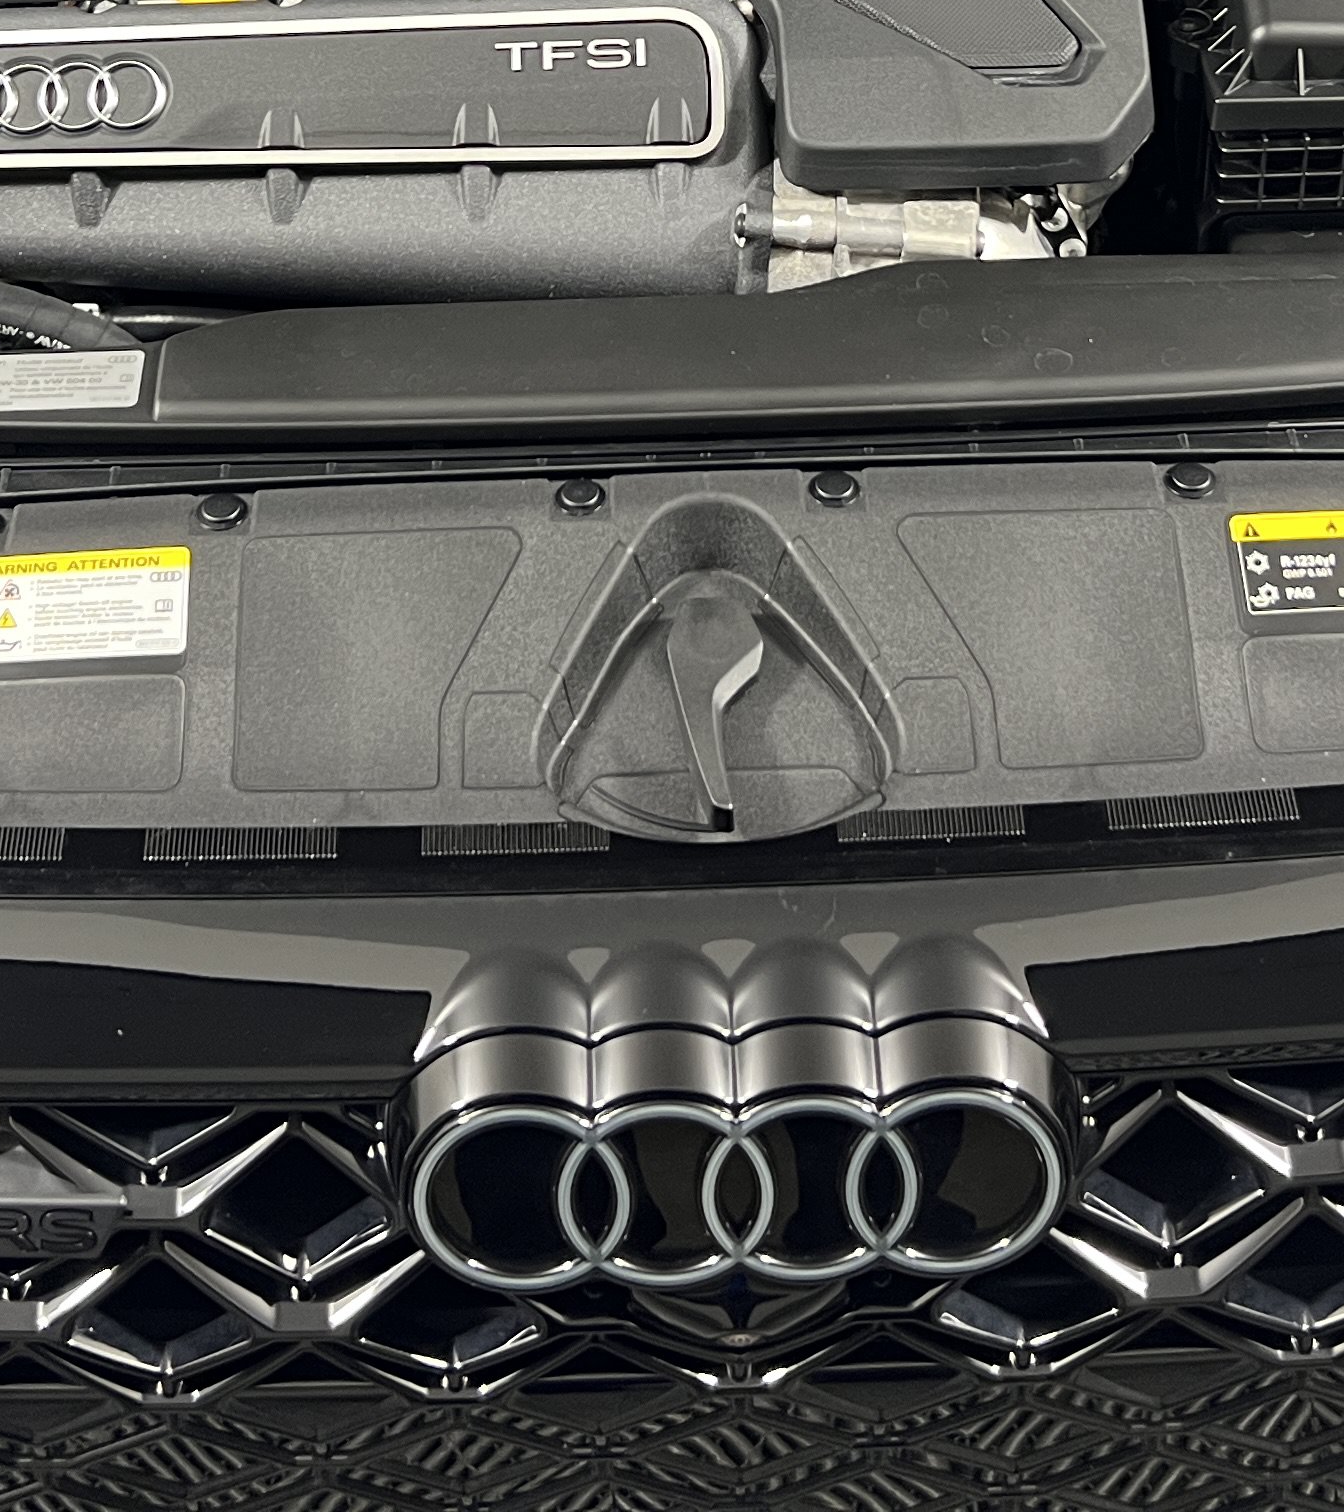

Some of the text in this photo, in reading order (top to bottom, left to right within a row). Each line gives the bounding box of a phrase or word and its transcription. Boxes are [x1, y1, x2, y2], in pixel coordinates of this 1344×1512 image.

[494, 38, 647, 71] TFSI
[43, 377, 65, 385] VW
[67, 555, 161, 573] ATTENTION
[1279, 552, 1336, 568] R-1234yf
[1284, 585, 1316, 601] PAG
